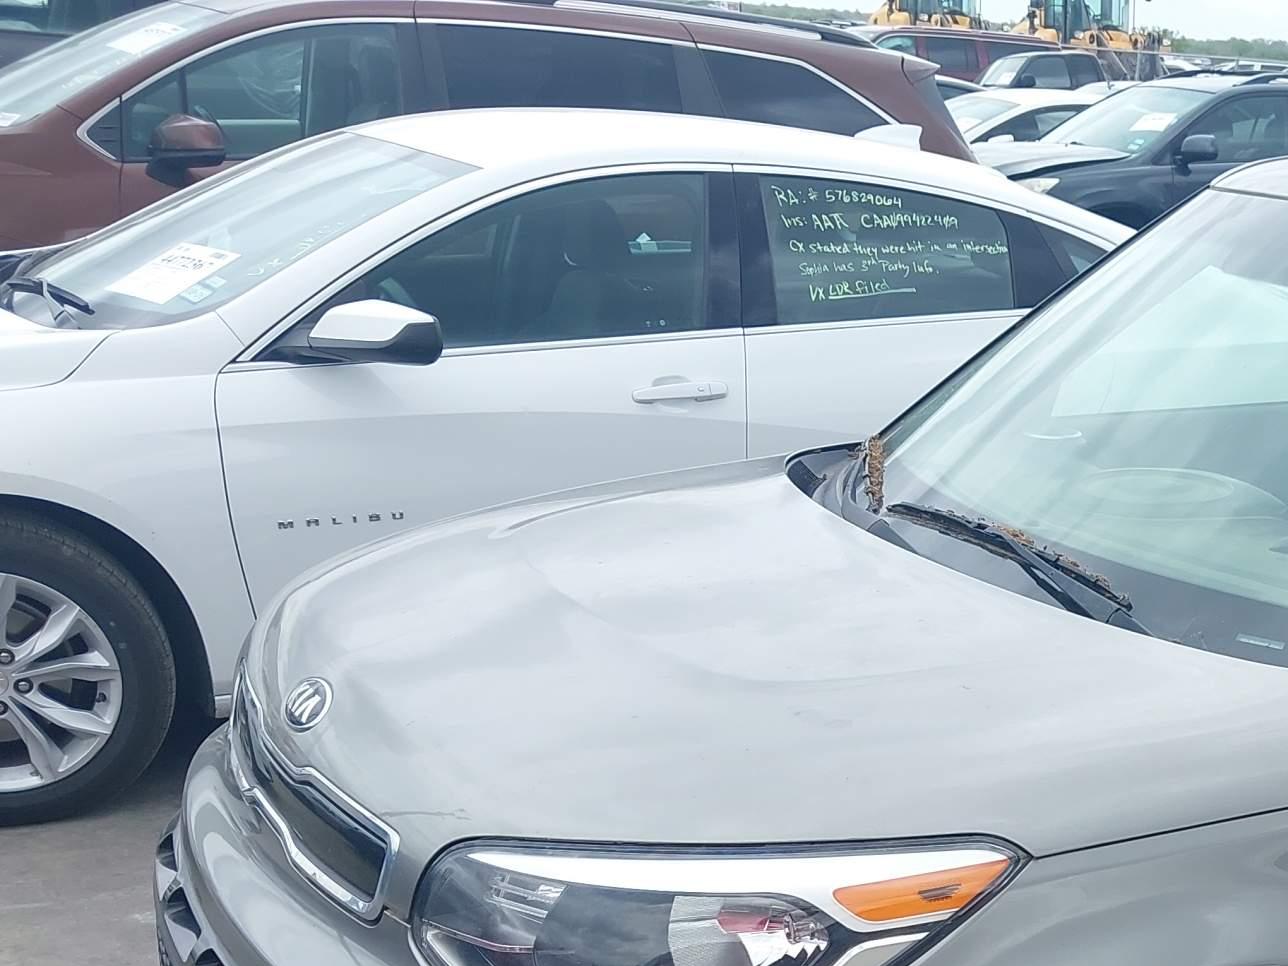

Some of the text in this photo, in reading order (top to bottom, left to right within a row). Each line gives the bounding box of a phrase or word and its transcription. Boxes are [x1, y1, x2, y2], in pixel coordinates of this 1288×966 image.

[825, 189, 902, 209] 576829064
[833, 261, 855, 272] has
[277, 511, 404, 530] MALIBU
